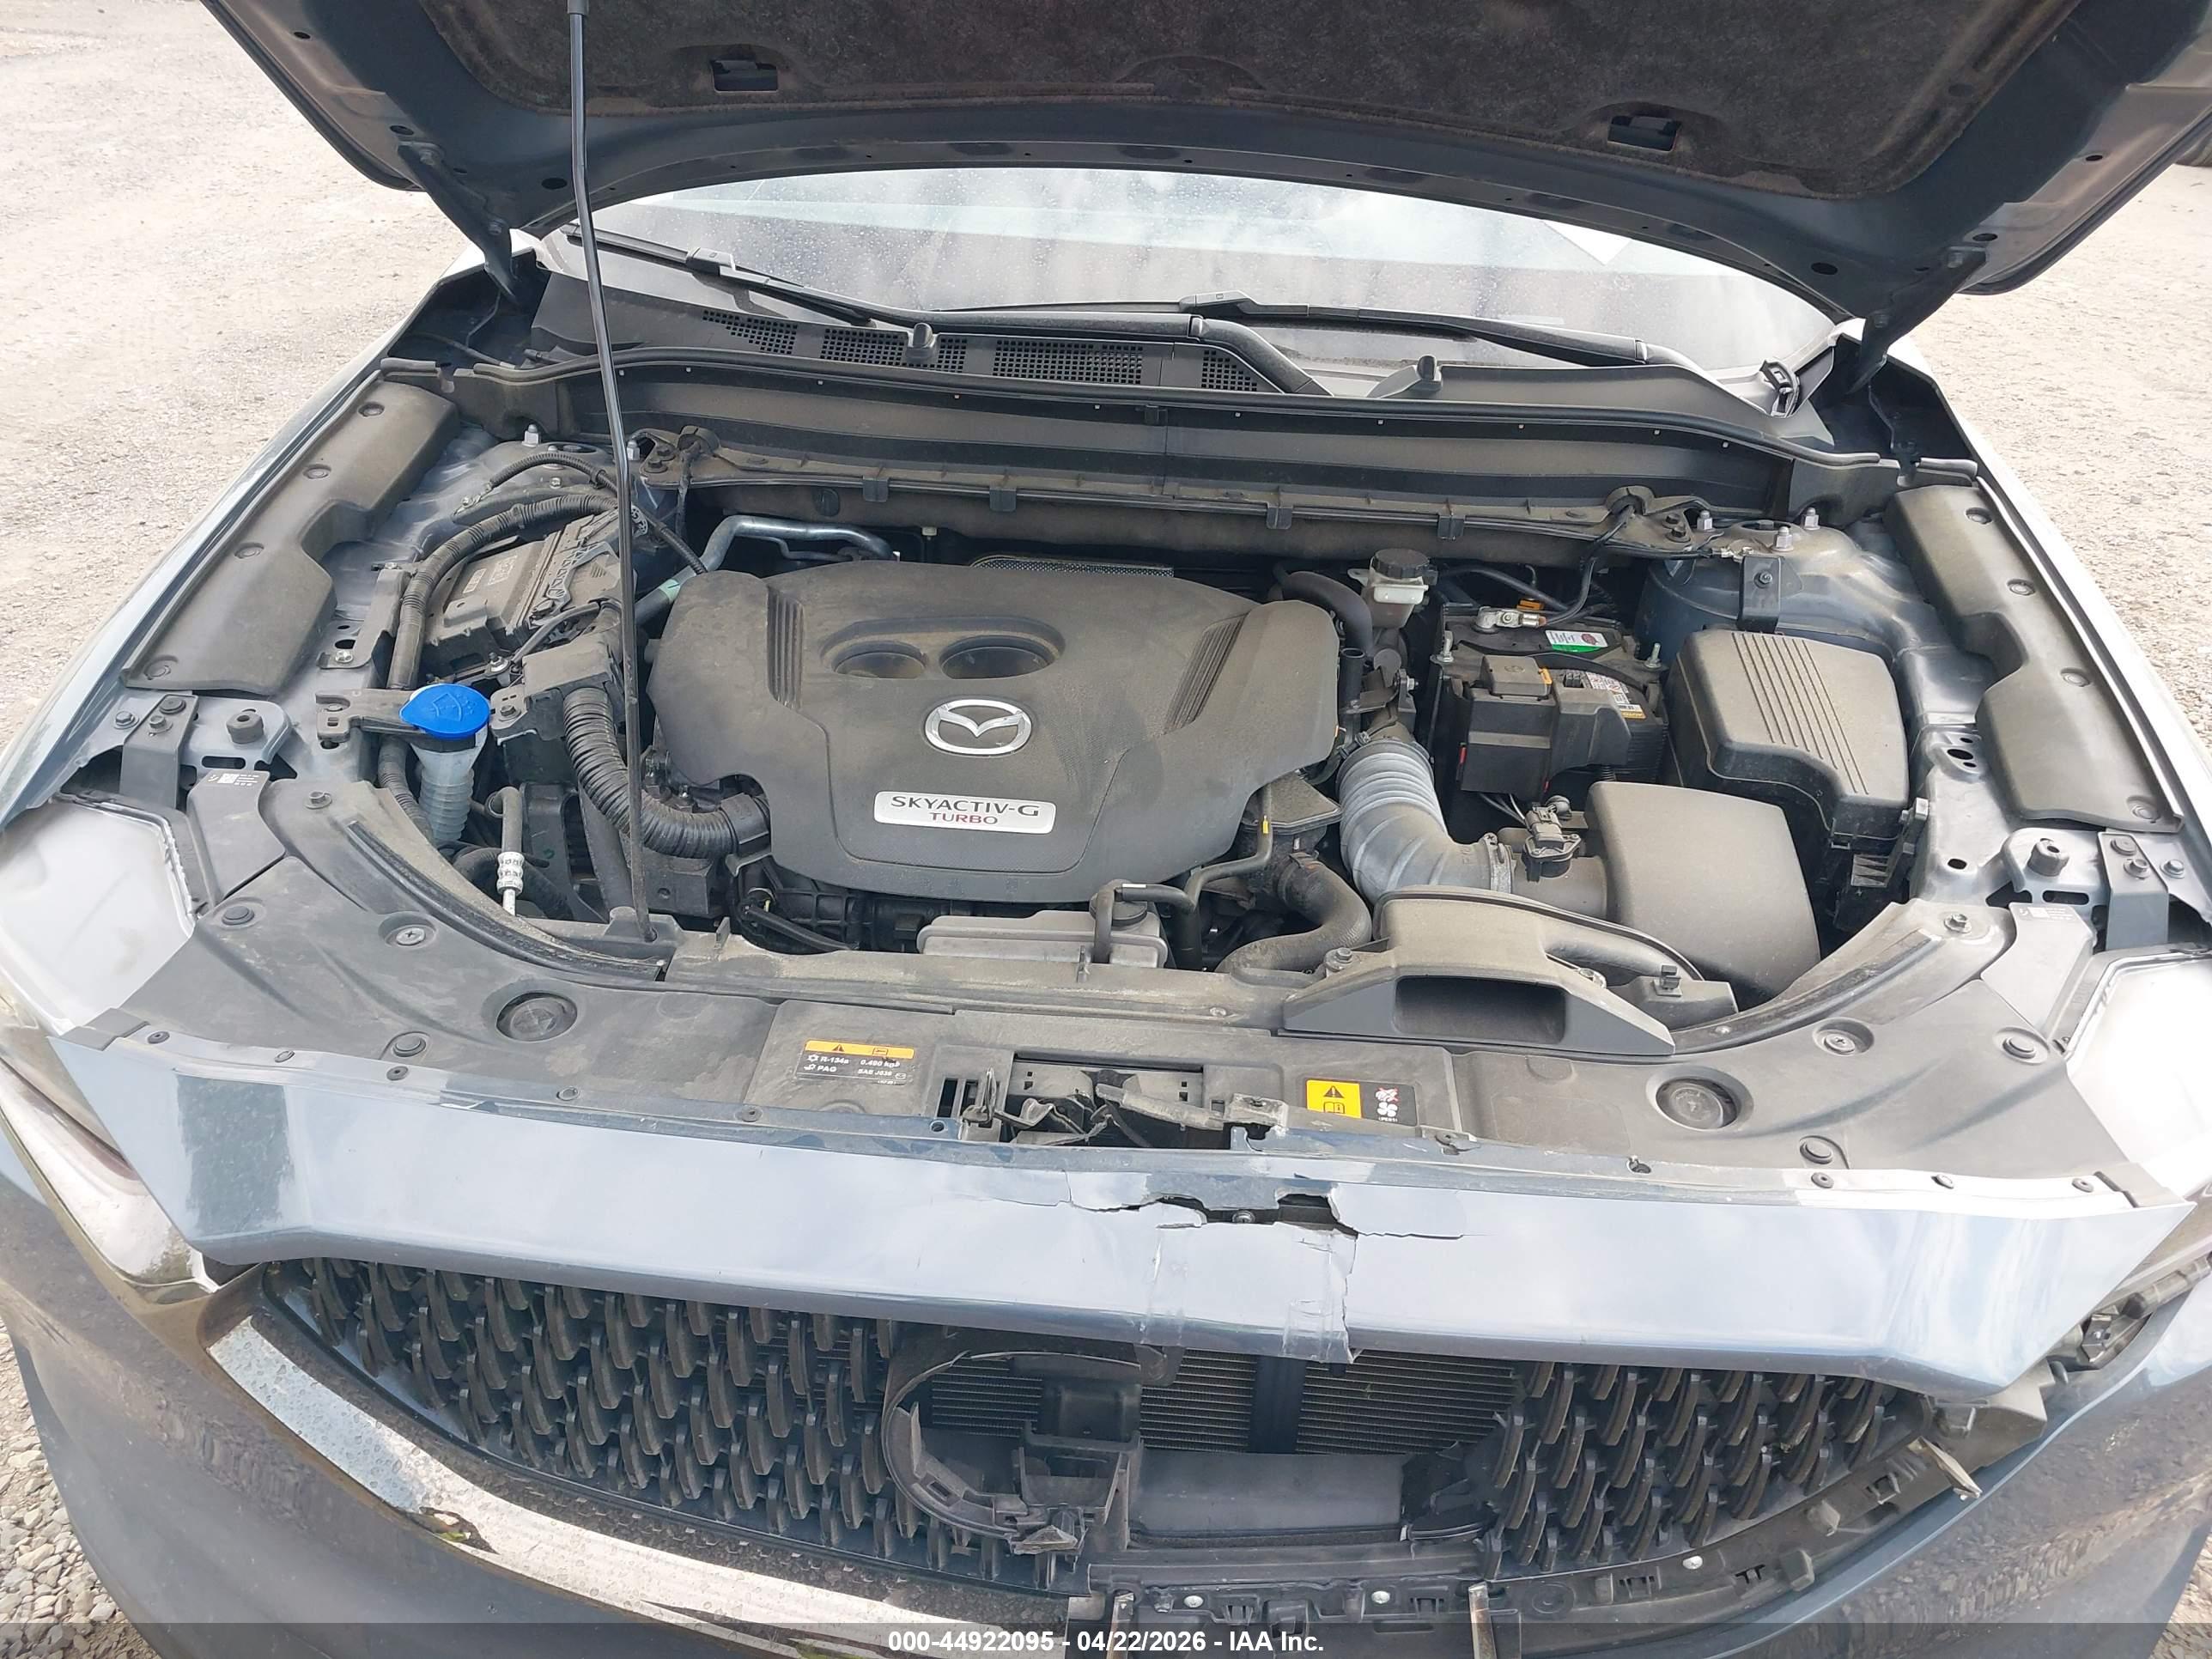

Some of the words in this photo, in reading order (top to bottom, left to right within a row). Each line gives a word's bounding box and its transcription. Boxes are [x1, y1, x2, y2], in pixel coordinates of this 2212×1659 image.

[890, 796, 1040, 817] SKYACTIV-G
[929, 811, 999, 825] TURBO
[820, 1056, 849, 1065] R-134a
